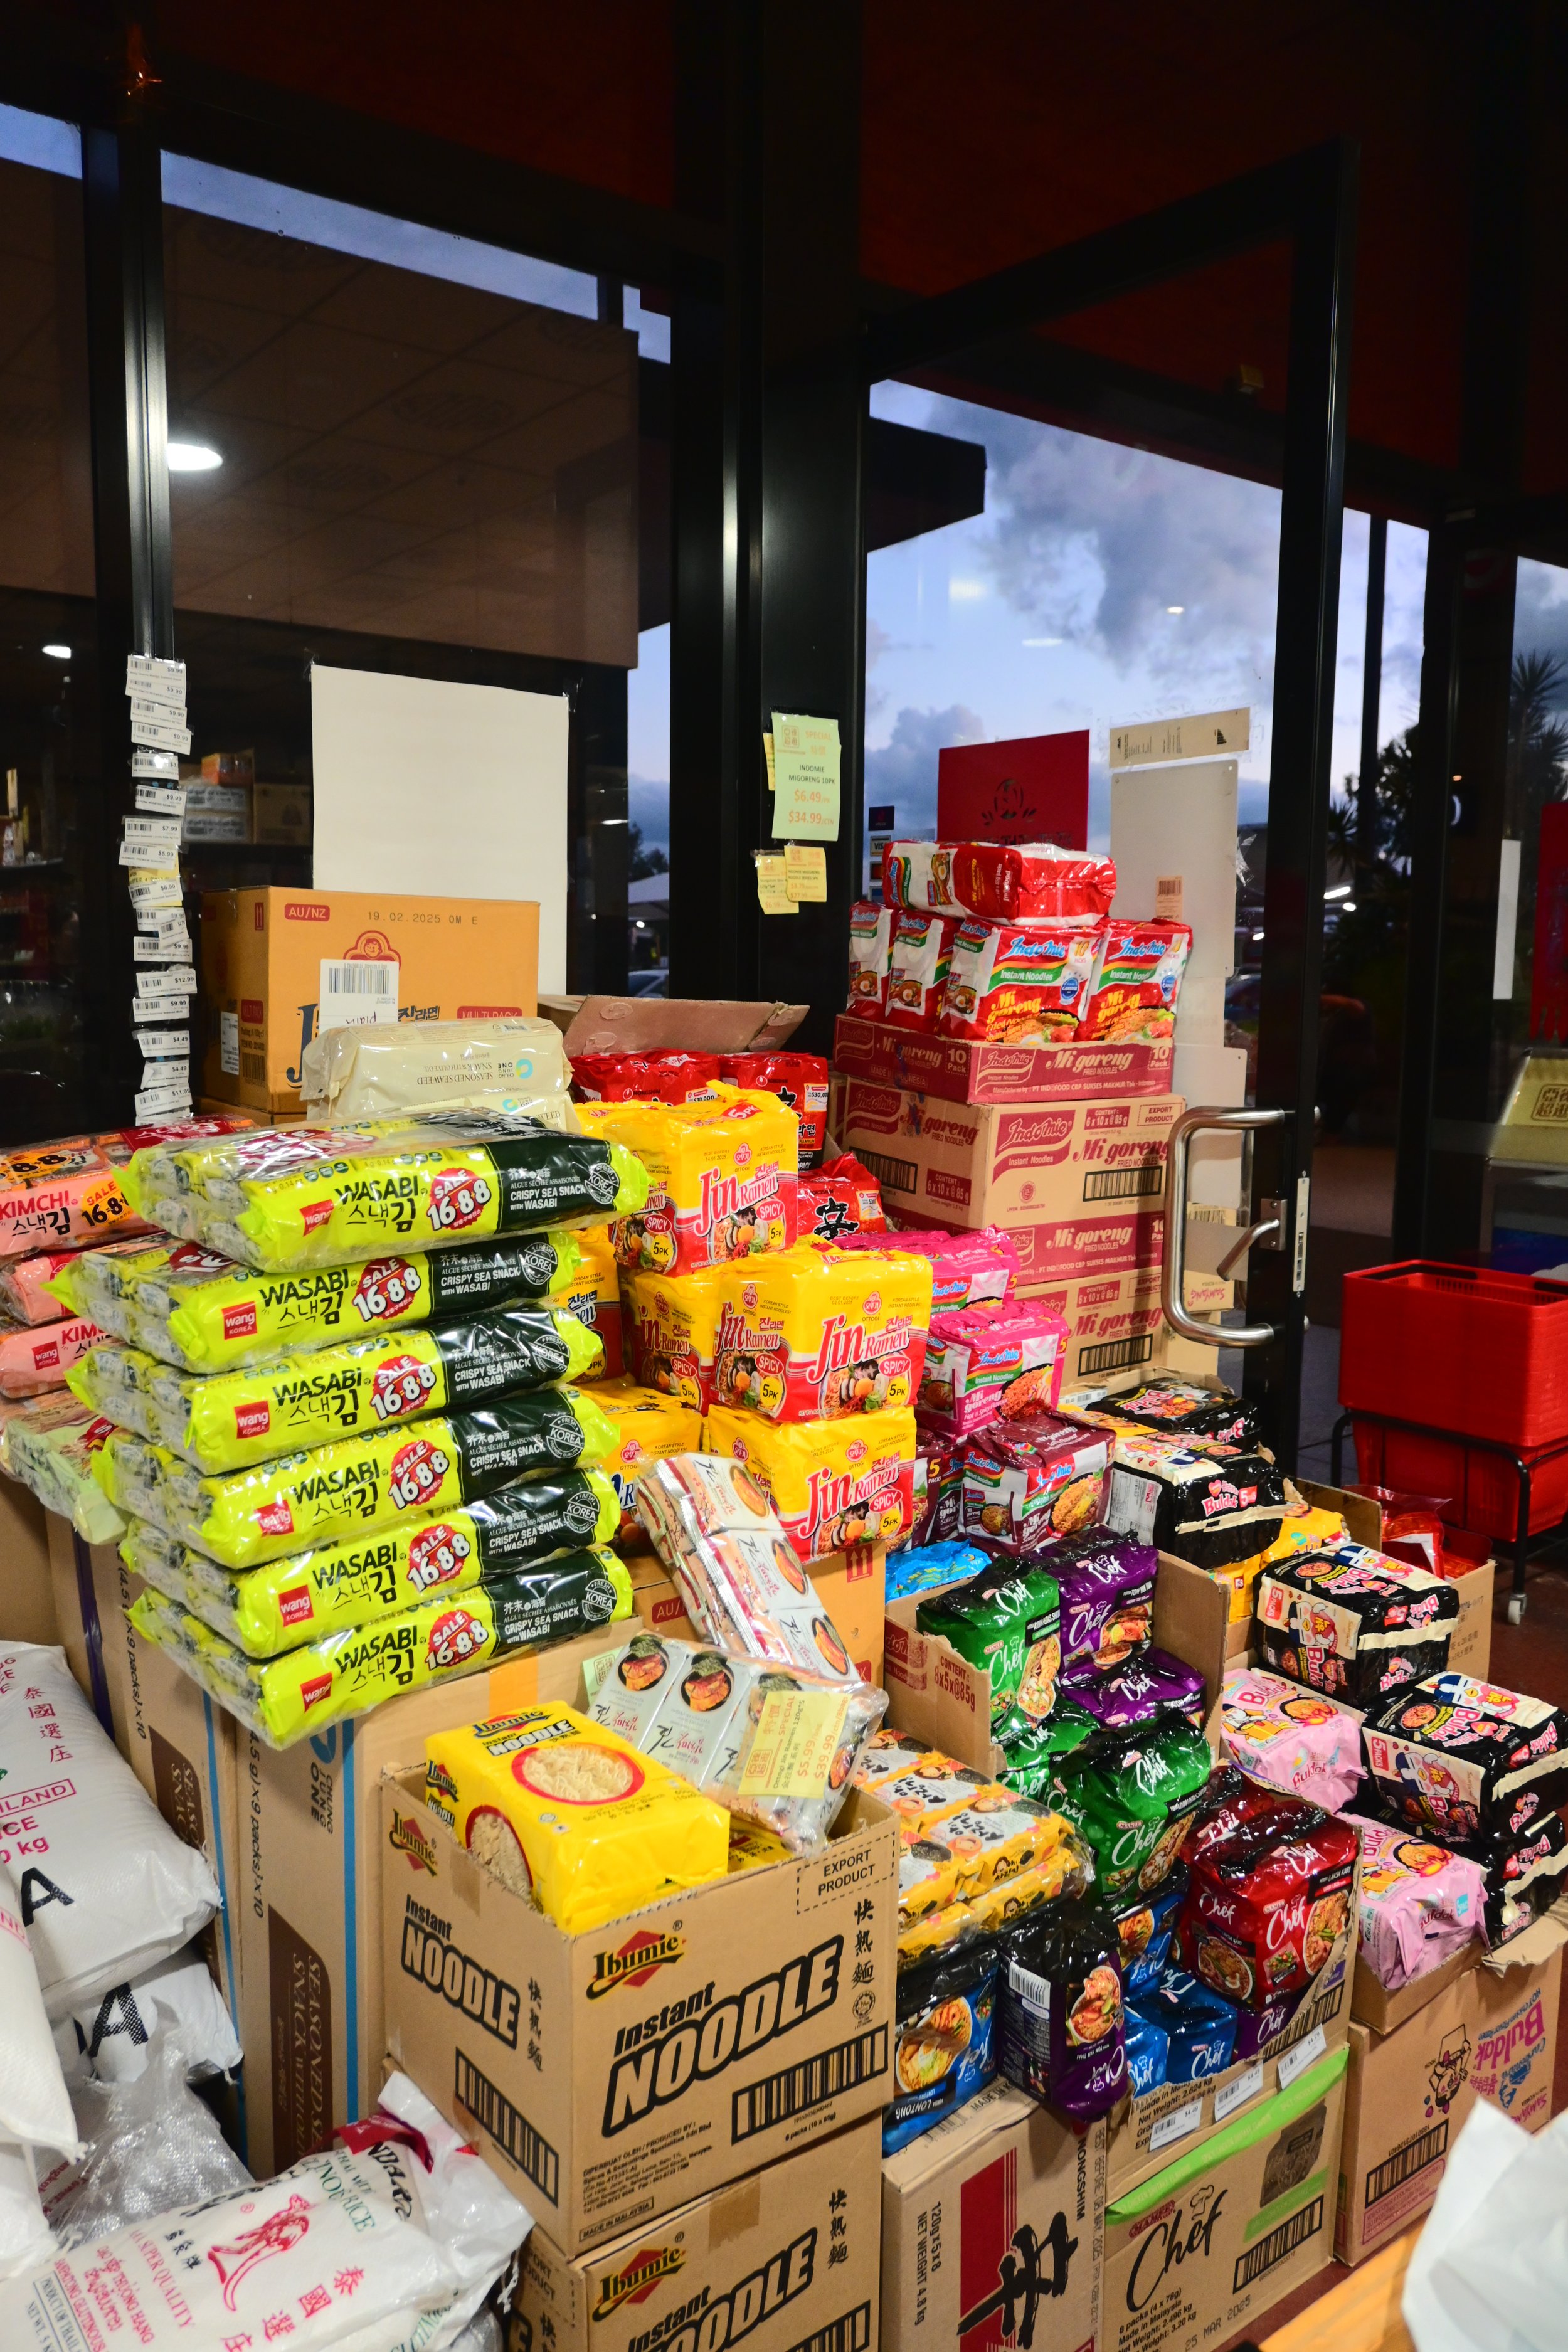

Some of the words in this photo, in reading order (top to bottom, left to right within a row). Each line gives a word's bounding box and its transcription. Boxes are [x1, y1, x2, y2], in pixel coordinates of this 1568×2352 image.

[805, 730, 832, 741] SPECIAL
[788, 774, 820, 783] MIGORENG
[800, 765, 825, 773] INDOMIE
[289, 906, 326, 919] AU/NZ
[368, 911, 441, 924] 19.02.2025
[1000, 970, 1024, 980] Instant
[1025, 972, 1053, 981] Noodles
[1110, 970, 1132, 979] Instant
[987, 997, 1042, 1024] goreng
[948, 1048, 967, 1064] 10
[1046, 1051, 1074, 1069] Mi
[1073, 1051, 1134, 1073] goreng
[1152, 1046, 1170, 1059] 10
[467, 1062, 492, 1071] SNACK
[871, 1066, 887, 1077] MADE
[948, 1063, 967, 1073] Pack
[1150, 1059, 1168, 1067] Pack
[417, 1075, 453, 1085] SEAWEED
[454, 1071, 493, 1082] SEASONED
[1145, 1115, 1173, 1123] PRODUCT
[931, 1132, 944, 1142] FRIED
[945, 1135, 964, 1146] NOODLES
[1073, 1138, 1106, 1161] Mi
[1009, 1157, 1029, 1166] Instant
[1031, 1155, 1054, 1165] Noodles
[1133, 1157, 1158, 1165] NOODLES
[755, 1161, 779, 1180] 진라면
[336, 1175, 418, 1207] WASABI
[434, 1169, 468, 1197] SALE
[511, 1189, 539, 1201] CRISPY
[542, 1187, 558, 1198] SEA
[559, 1184, 586, 1195] SNACK
[740, 1176, 777, 1207] Ramen
[0, 1191, 70, 1221] KIMCHI
[524, 1198, 558, 1210] WASABI
[760, 1203, 782, 1218] SPICY
[770, 1227, 782, 1239] 5PK
[1046, 1227, 1074, 1249] Mi
[1074, 1227, 1133, 1250] goreng
[1086, 1259, 1104, 1267] SUKSES
[1104, 1256, 1127, 1265] MAKMUR
[363, 1258, 398, 1286] SALE
[223, 1311, 255, 1328] wang
[759, 1317, 785, 1331] 진라면
[885, 1315, 913, 1333] 진라면
[228, 1325, 253, 1335] KOREA
[807, 1315, 864, 1384] Jin
[864, 1330, 908, 1360] Ramen
[759, 1357, 780, 1374] SPICY
[884, 1359, 909, 1374] SPICY
[763, 1384, 778, 1399] 5PK
[889, 1384, 906, 1396] 5PK
[236, 1410, 269, 1429] wang
[242, 1426, 267, 1436] KOREA
[849, 1461, 865, 1470] OTTOGI
[291, 1461, 381, 1505] WASABI
[578, 1493, 595, 1504] FRESH
[798, 1467, 852, 1539] Jin
[854, 1468, 897, 1503] Ramen
[873, 1491, 898, 1510] SPICY
[1202, 1488, 1239, 1517] Buldak
[566, 1504, 596, 1521] KOREA
[882, 1517, 898, 1527] 5PK
[413, 1525, 448, 1561] SALE
[313, 1544, 398, 1589] WASABI
[280, 1597, 310, 1614] wang
[504, 1614, 522, 1623] ALGUE
[504, 1619, 535, 1635] CRISPY
[536, 1616, 552, 1626] SEA
[553, 1606, 579, 1622] SNACK
[336, 1626, 418, 1668] WASABI
[507, 1635, 519, 1643] WITH
[779, 1696, 795, 1735] SPECIAL
[486, 1719, 576, 1756] NOODLE
[773, 1764, 783, 1788] Ottogi
[785, 1727, 797, 1752] Ramen
[310, 1762, 320, 1821] ONE
[319, 1772, 327, 1828] JUNG
[325, 1775, 334, 1834] CHUNG
[824, 1849, 872, 1879] EXPORT
[817, 1865, 876, 1897] PRODUCT
[21, 1867, 74, 1927] A
[1266, 1896, 1306, 1949] Chef
[852, 1899, 876, 1989] 快熟麵
[586, 1933, 685, 2000] Ibumie
[401, 1917, 521, 2050] NOODLE
[614, 1981, 716, 2057] Instant
[601, 1935, 844, 2137] NOODLE
[1474, 2000, 1545, 2071] Buldak
[895, 2100, 931, 2120] LONTONG
[1138, 2111, 1152, 2126] Net
[1076, 2138, 1086, 2221] NONGSHIM
[917, 2211, 927, 2236] NET
[1127, 2189, 1228, 2312] Chef
[917, 2237, 927, 2286] WEIGHT
[593, 2248, 686, 2322] Ibumie
[153, 2268, 195, 2329] QUALITY
[917, 2287, 927, 2307] 4.8
[914, 2312, 925, 2326] kg
[1119, 2326, 1125, 2334] 8
[1126, 2312, 1148, 2330] packs
[1119, 2329, 1139, 2346] Made
[1141, 2323, 1148, 2331] in
[1150, 2300, 1182, 2324] Malaysia
[1133, 2326, 1161, 2347] Weight:
[1163, 2311, 1182, 2328] 2.496
[1184, 2303, 1192, 2314] kg
[1171, 2319, 1186, 2333] 3.20
[1204, 2317, 1222, 2339] MAR
[1227, 2294, 1251, 2321] 2025
